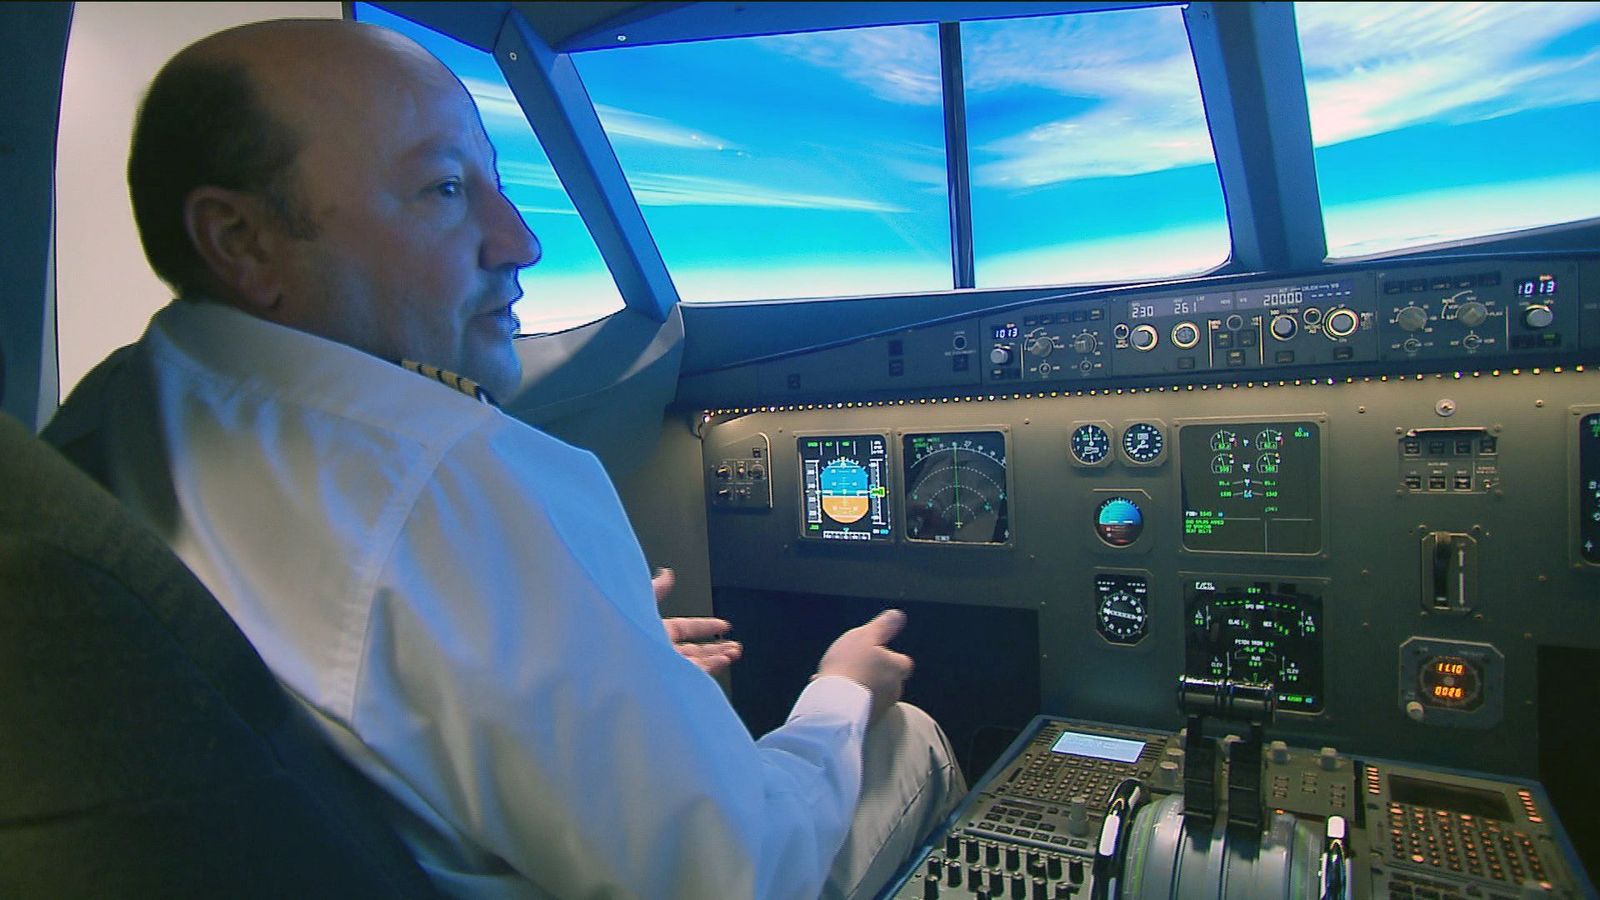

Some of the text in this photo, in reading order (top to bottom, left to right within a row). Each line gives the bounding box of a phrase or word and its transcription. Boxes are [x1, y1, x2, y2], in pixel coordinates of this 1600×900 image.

[1518, 281, 1555, 295] 1013
[1263, 291, 1303, 306] 20000
[1131, 305, 1154, 318] 230
[1174, 301, 1197, 314] 261
[995, 327, 1018, 339] 1013
